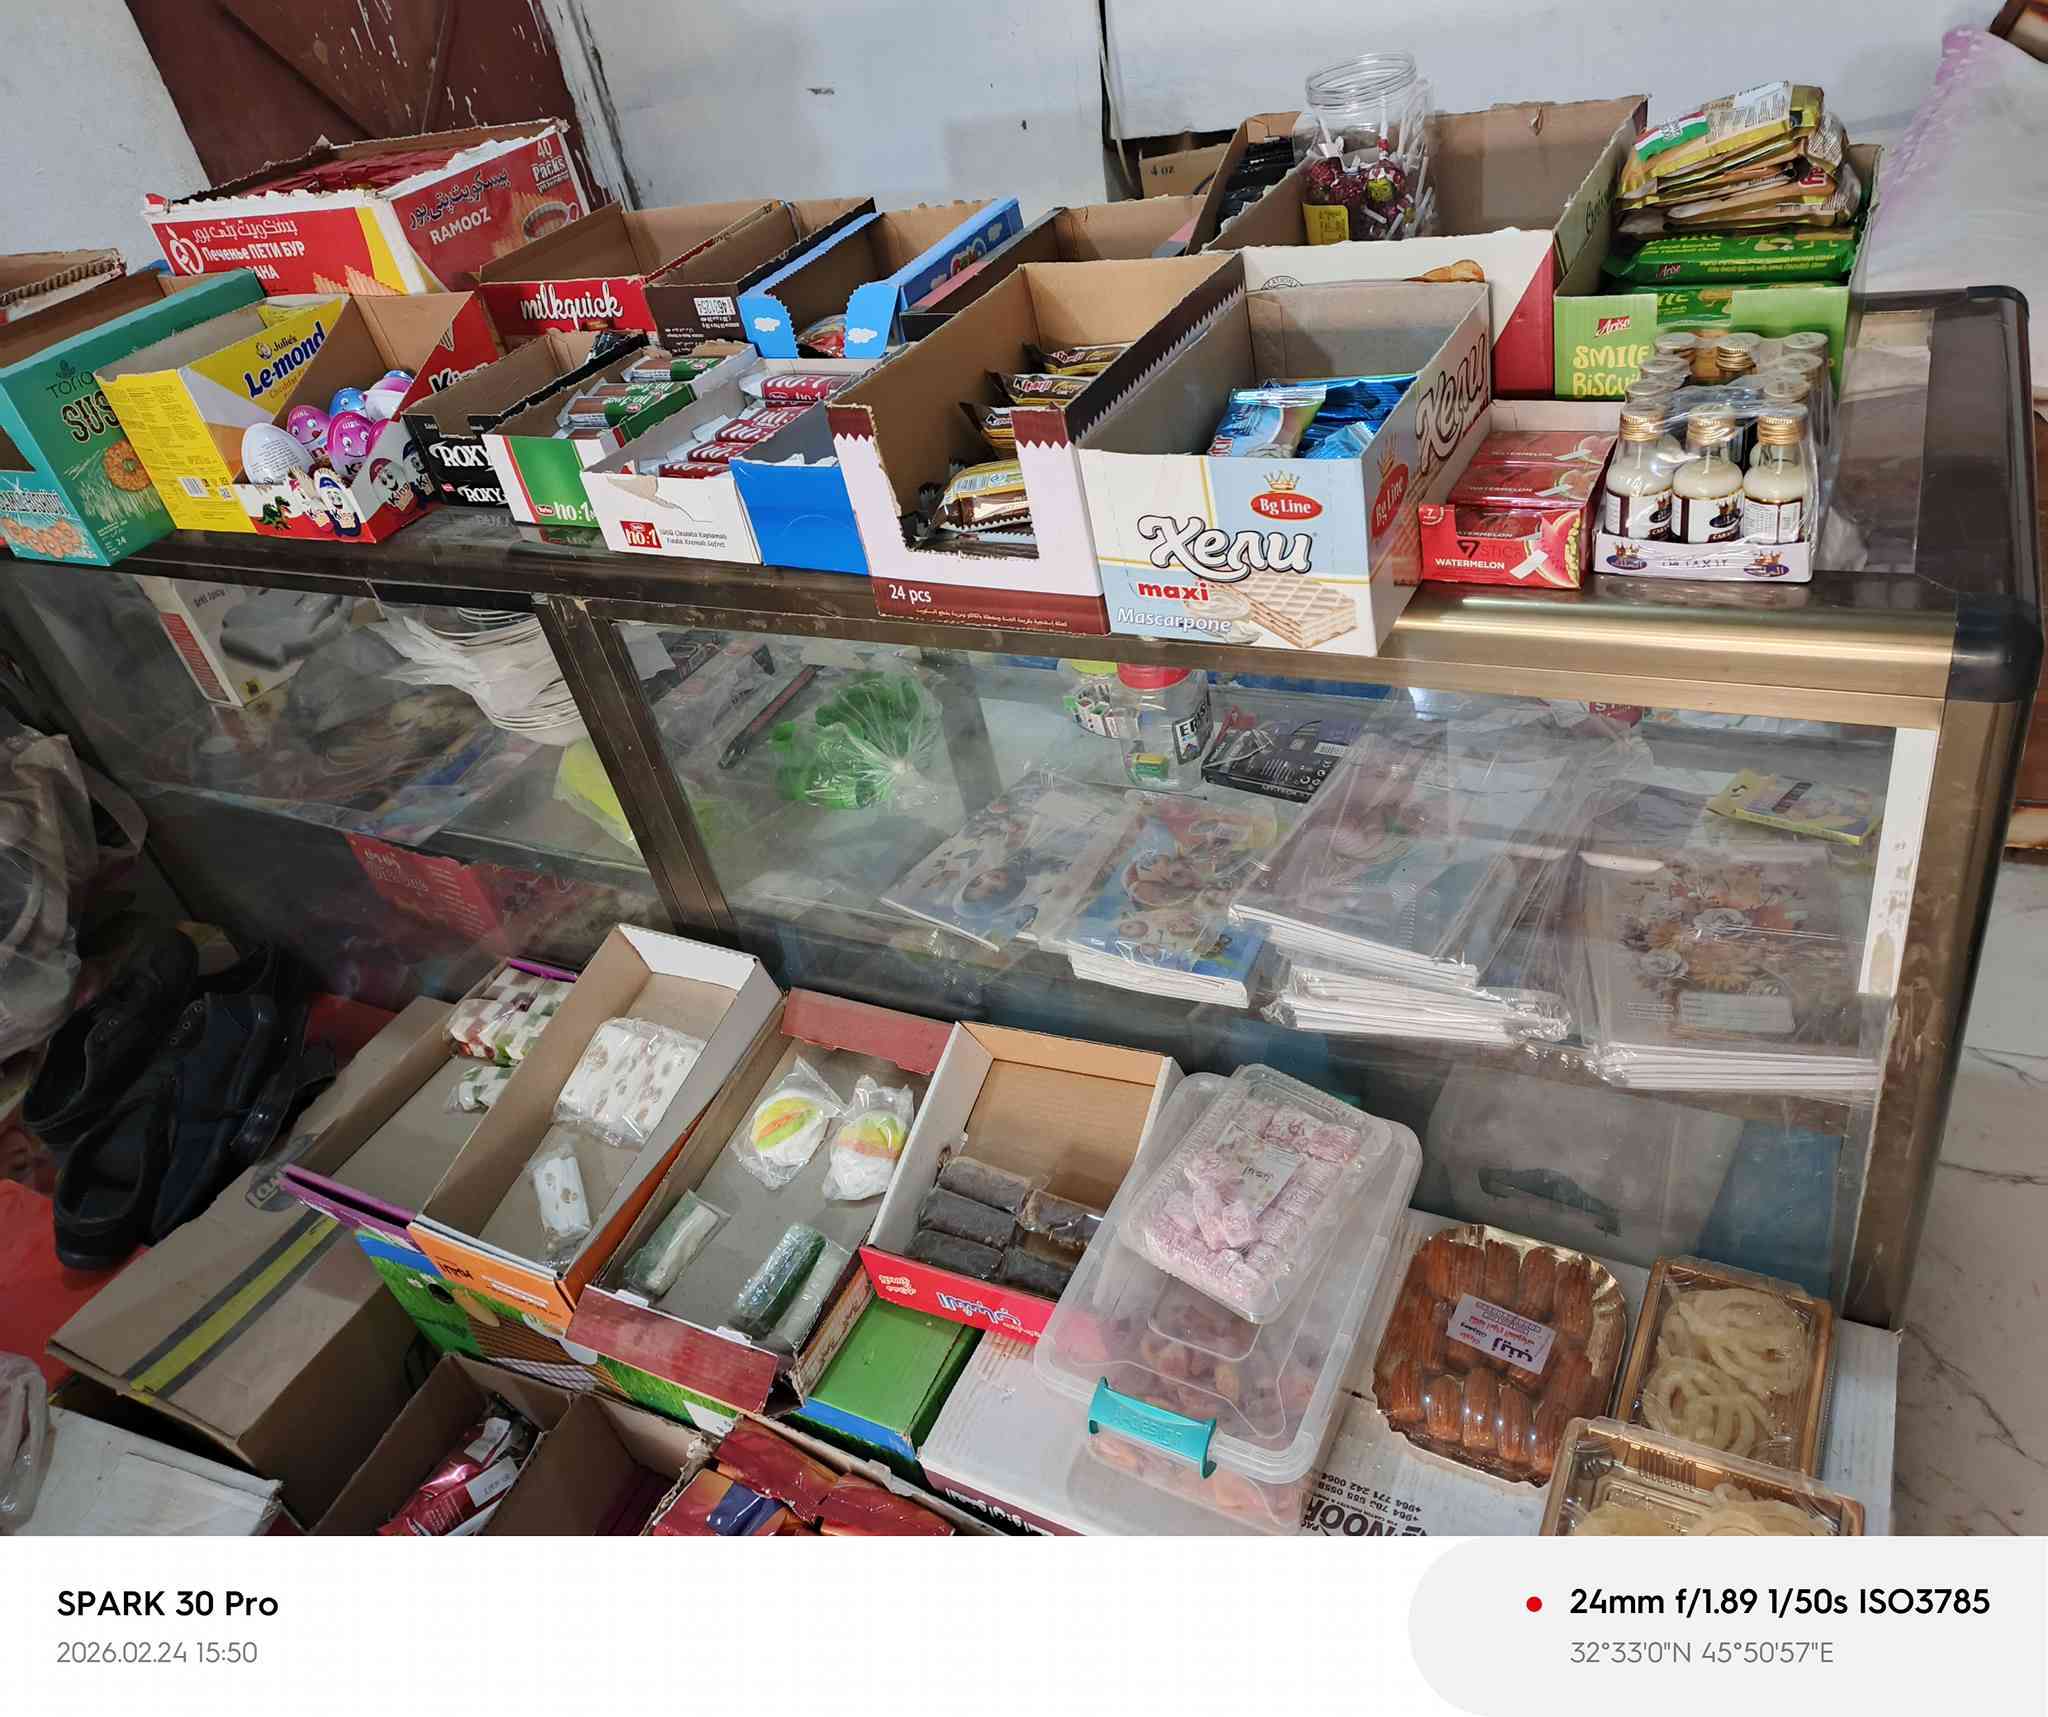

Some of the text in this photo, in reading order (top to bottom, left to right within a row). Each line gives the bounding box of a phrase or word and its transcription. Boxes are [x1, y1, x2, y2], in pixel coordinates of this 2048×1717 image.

[536, 139, 552, 158] 40
[531, 157, 567, 182] Packs
[429, 206, 492, 246] RAMOOZ
[250, 242, 283, 259] ПЕТИ
[283, 240, 305, 258] БУР
[521, 281, 625, 331] milkquick
[1260, 498, 1313, 515] Bg Line
[1434, 558, 1506, 570] WATERMELON
[888, 584, 932, 605] 24 pcs
[1138, 582, 1210, 602] maxi
[1117, 606, 1233, 634] Mascarpone
